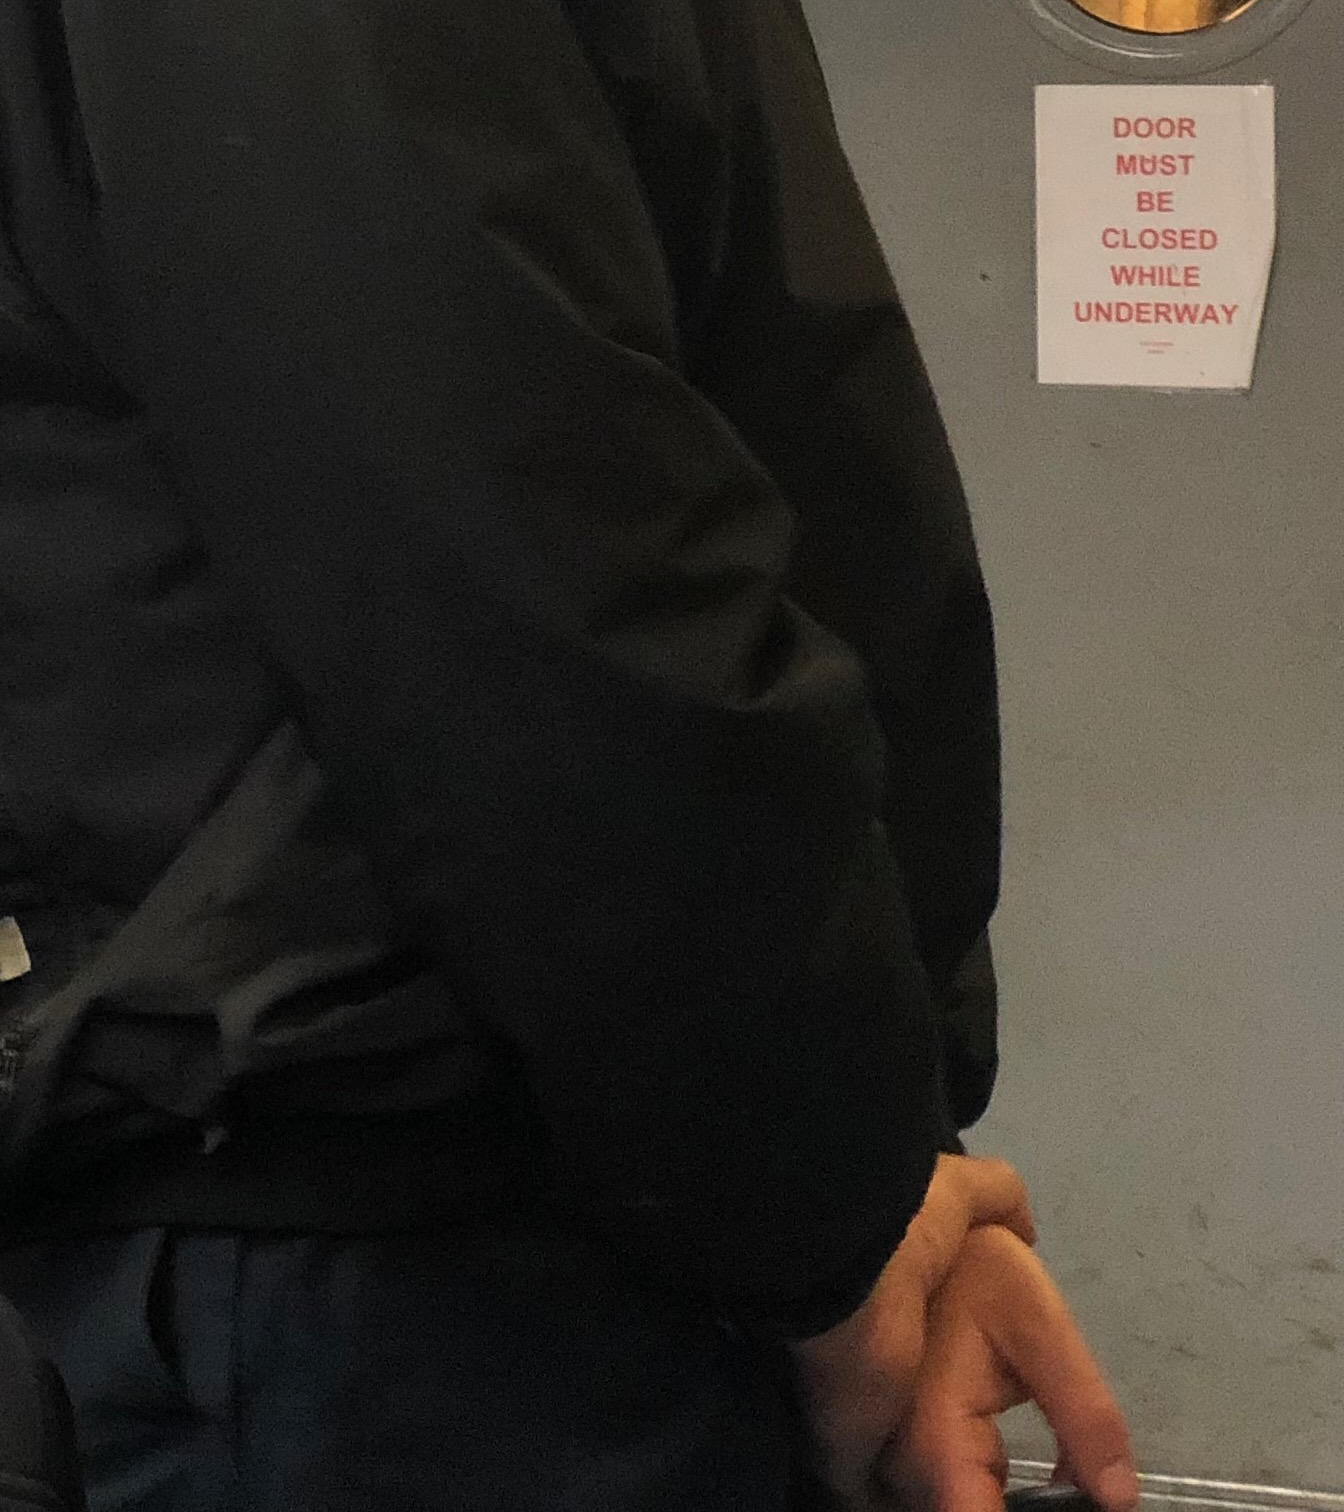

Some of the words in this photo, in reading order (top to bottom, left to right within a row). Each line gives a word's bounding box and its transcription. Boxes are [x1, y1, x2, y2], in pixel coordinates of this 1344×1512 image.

[1113, 116, 1197, 139] DOOR
[1116, 154, 1195, 176] MUST
[1136, 191, 1175, 213] BE
[1101, 227, 1219, 251] CLOSED
[1109, 264, 1201, 288] WHILE
[1073, 301, 1240, 326] UNDERWAY
